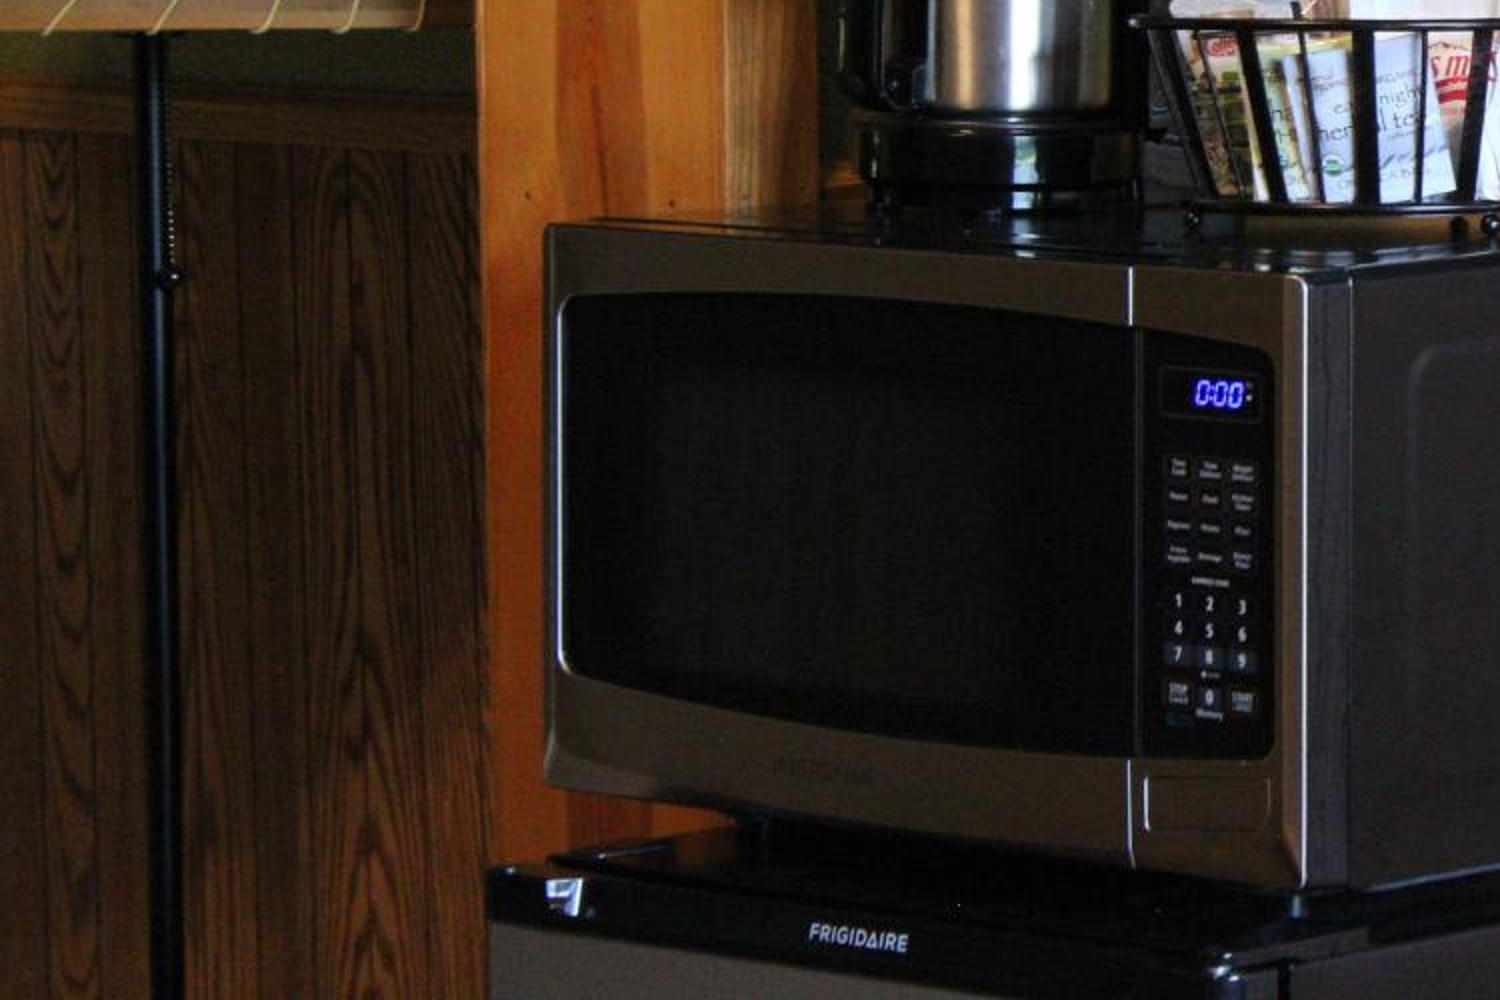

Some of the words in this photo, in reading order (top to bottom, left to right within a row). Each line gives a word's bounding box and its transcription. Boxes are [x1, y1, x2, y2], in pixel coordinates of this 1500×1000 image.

[1195, 379, 1245, 409] 0:00
[1205, 596, 1214, 611] 2
[1174, 620, 1183, 634] 4
[1205, 623, 1214, 638] 5
[1174, 646, 1183, 661] 7
[808, 922, 909, 953] FRIGIDAIRE
